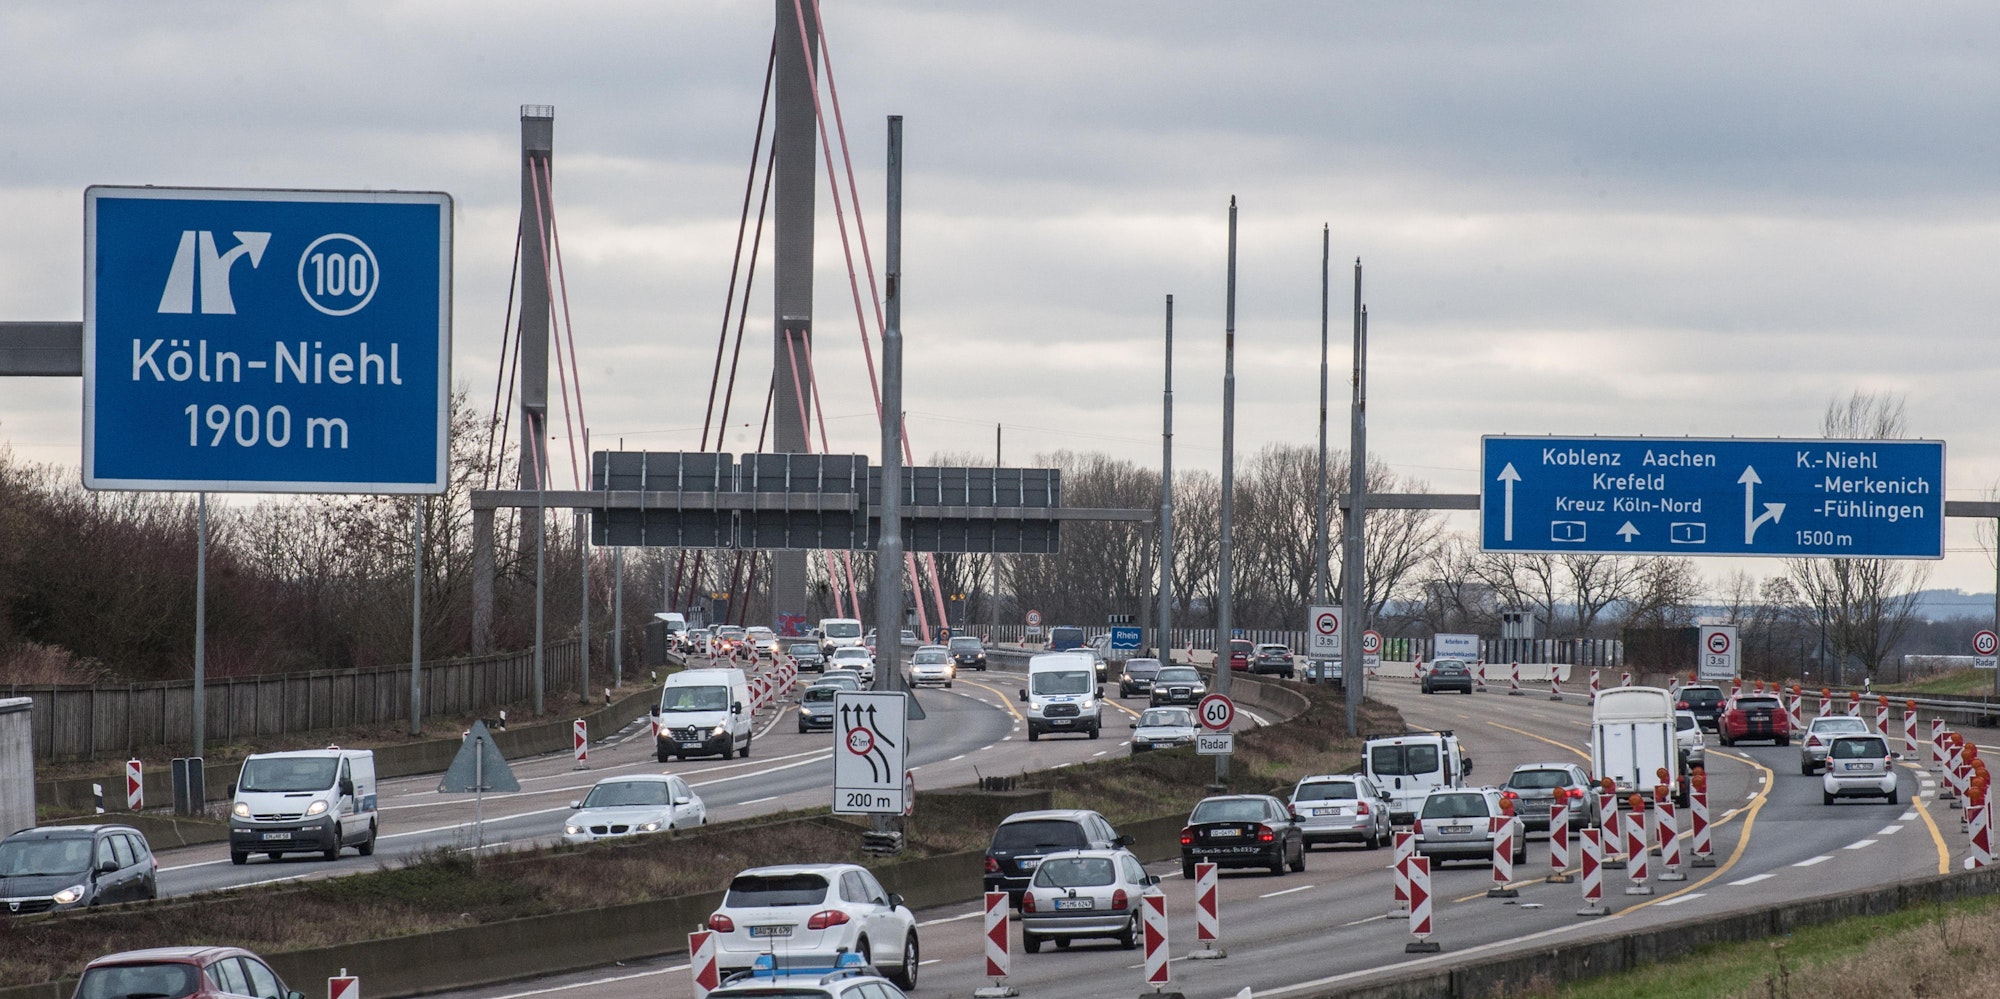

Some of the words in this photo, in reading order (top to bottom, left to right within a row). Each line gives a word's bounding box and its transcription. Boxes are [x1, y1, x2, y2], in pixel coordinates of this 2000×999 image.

[311, 253, 368, 296] 100
[132, 338, 402, 384] Köln-Niehl
[184, 404, 291, 448] 1900
[306, 417, 349, 449] m
[1542, 448, 1622, 466] Koblenz
[1642, 450, 1716, 467] Aachen
[1796, 451, 1879, 469] K.-Niehl
[1592, 473, 1665, 491] Krefeld
[1814, 476, 1930, 494] -Merkenich
[1556, 496, 1605, 512] Kreuz
[1613, 497, 1702, 513] Köln-Nord
[1813, 500, 1925, 523] -Fühlingen
[1565, 525, 1572, 538] 1
[1685, 526, 1692, 540] 1
[1795, 530, 1834, 546] 1500
[1836, 534, 1853, 546] m
[1116, 631, 1139, 640] Rhein
[1363, 637, 1377, 648] 60
[1978, 637, 1993, 649] 60
[1975, 658, 1996, 667] Radar
[1206, 704, 1227, 721] 60
[1200, 739, 1229, 750] Radar
[846, 793, 872, 808] 200
[876, 797, 891, 808] m
